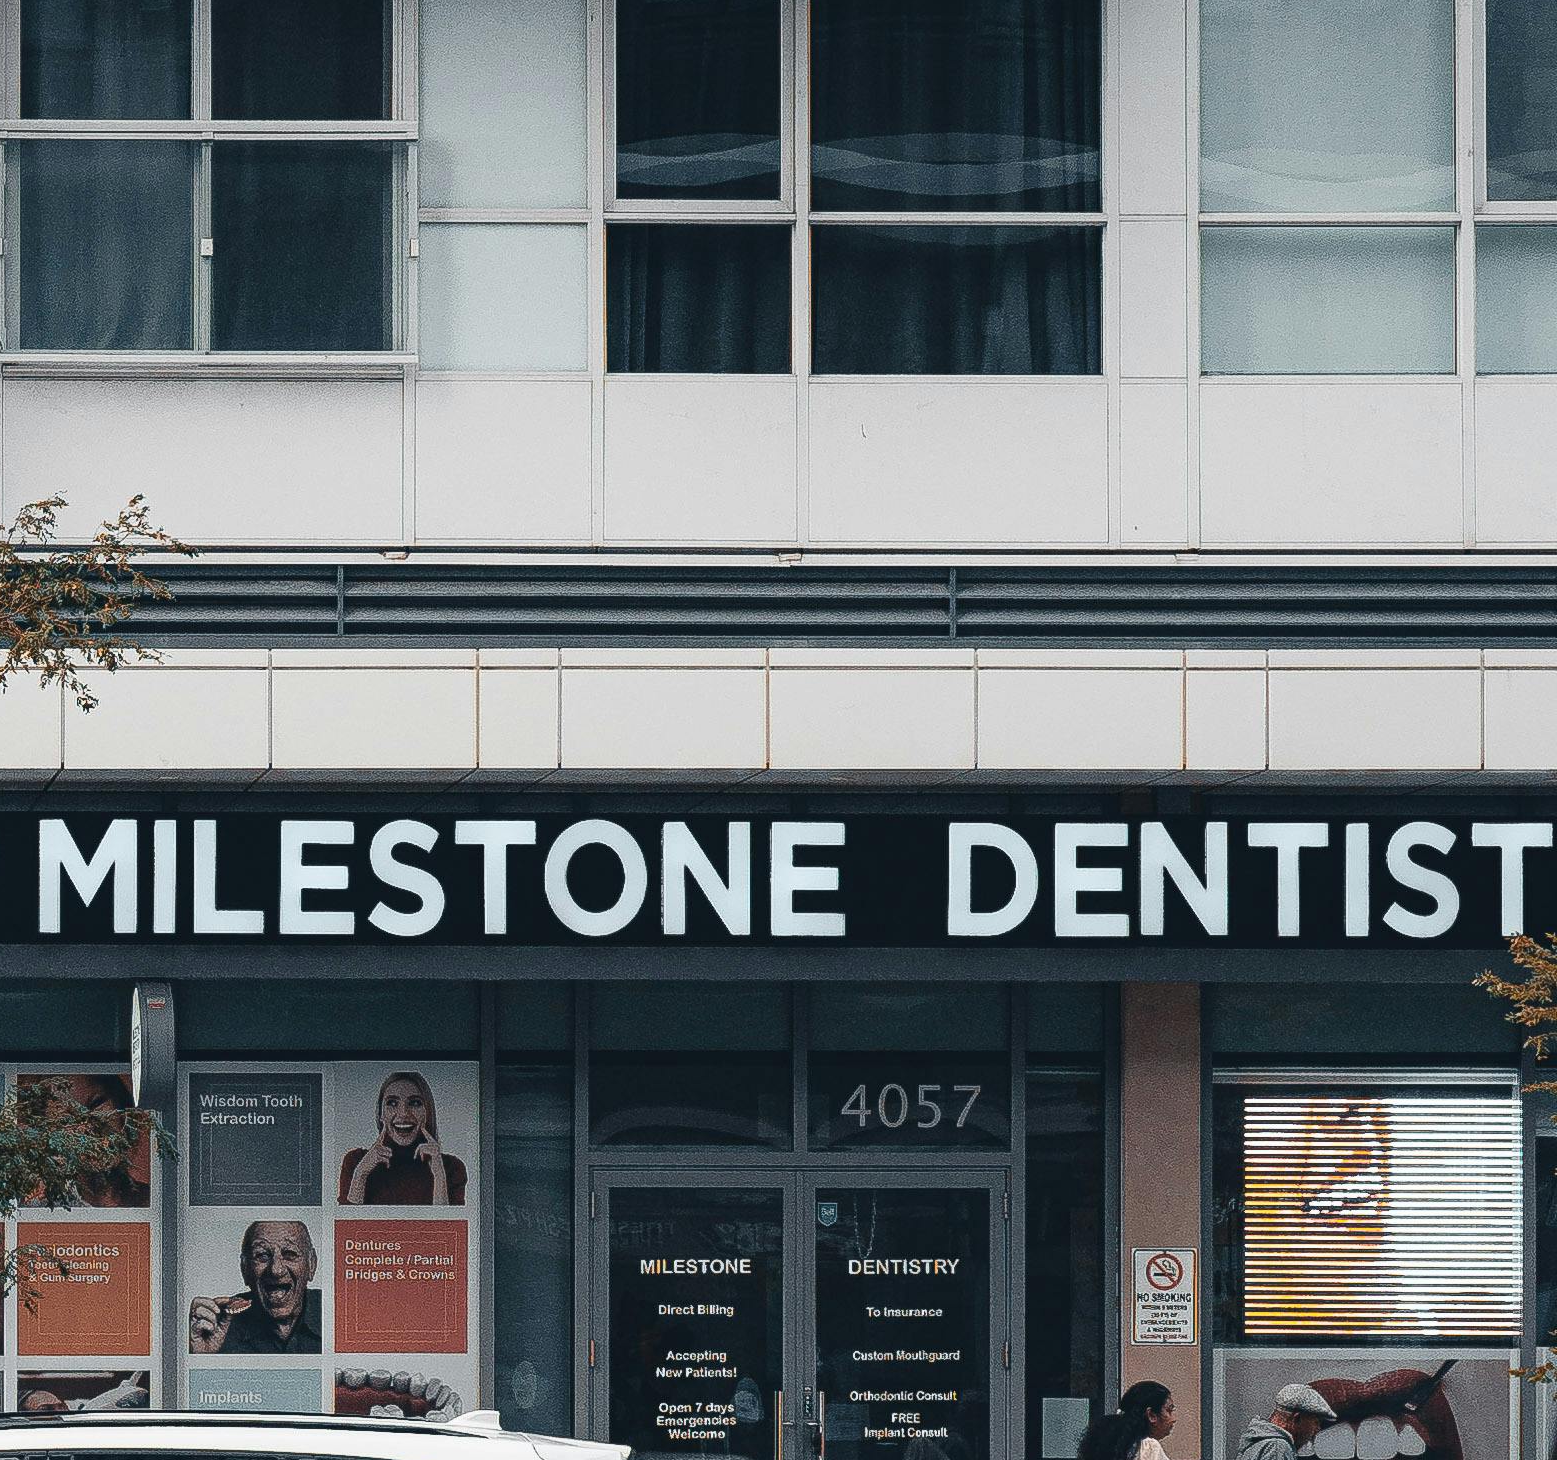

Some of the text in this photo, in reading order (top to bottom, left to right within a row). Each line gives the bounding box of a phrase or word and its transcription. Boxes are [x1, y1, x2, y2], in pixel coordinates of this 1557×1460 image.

[39, 819, 845, 936] MILESTONE
[199, 1094, 303, 1108] Wisdom Tooth
[841, 1084, 981, 1128] 4057
[200, 1112, 275, 1125] Extraction
[345, 1240, 401, 1251] Dentures
[345, 1255, 404, 1268] Complete
[414, 1255, 454, 1265] Partial
[640, 1259, 752, 1274] MILESTONE
[848, 1259, 960, 1275] DENTISTRY
[40, 1273, 65, 1282] Gum
[68, 1273, 111, 1284] Surgery
[345, 1269, 456, 1282] Bridges & Crowns
[1137, 1292, 1192, 1302] NO SMOKING
[658, 1304, 735, 1317] Direct Billing
[866, 1306, 943, 1317] To Insurance
[666, 1350, 727, 1363] Accepting
[852, 1350, 960, 1363] Custom Mouthguard
[655, 1366, 737, 1378] New Patients!
[199, 1391, 263, 1405] Implants
[849, 1390, 957, 1401] Orthodontic Consult
[658, 1402, 735, 1415] Open 7 days
[656, 1416, 736, 1428] Emergencies
[891, 1413, 921, 1424] FREE
[668, 1428, 726, 1439] Welcome
[864, 1427, 948, 1439] Implant Consult
